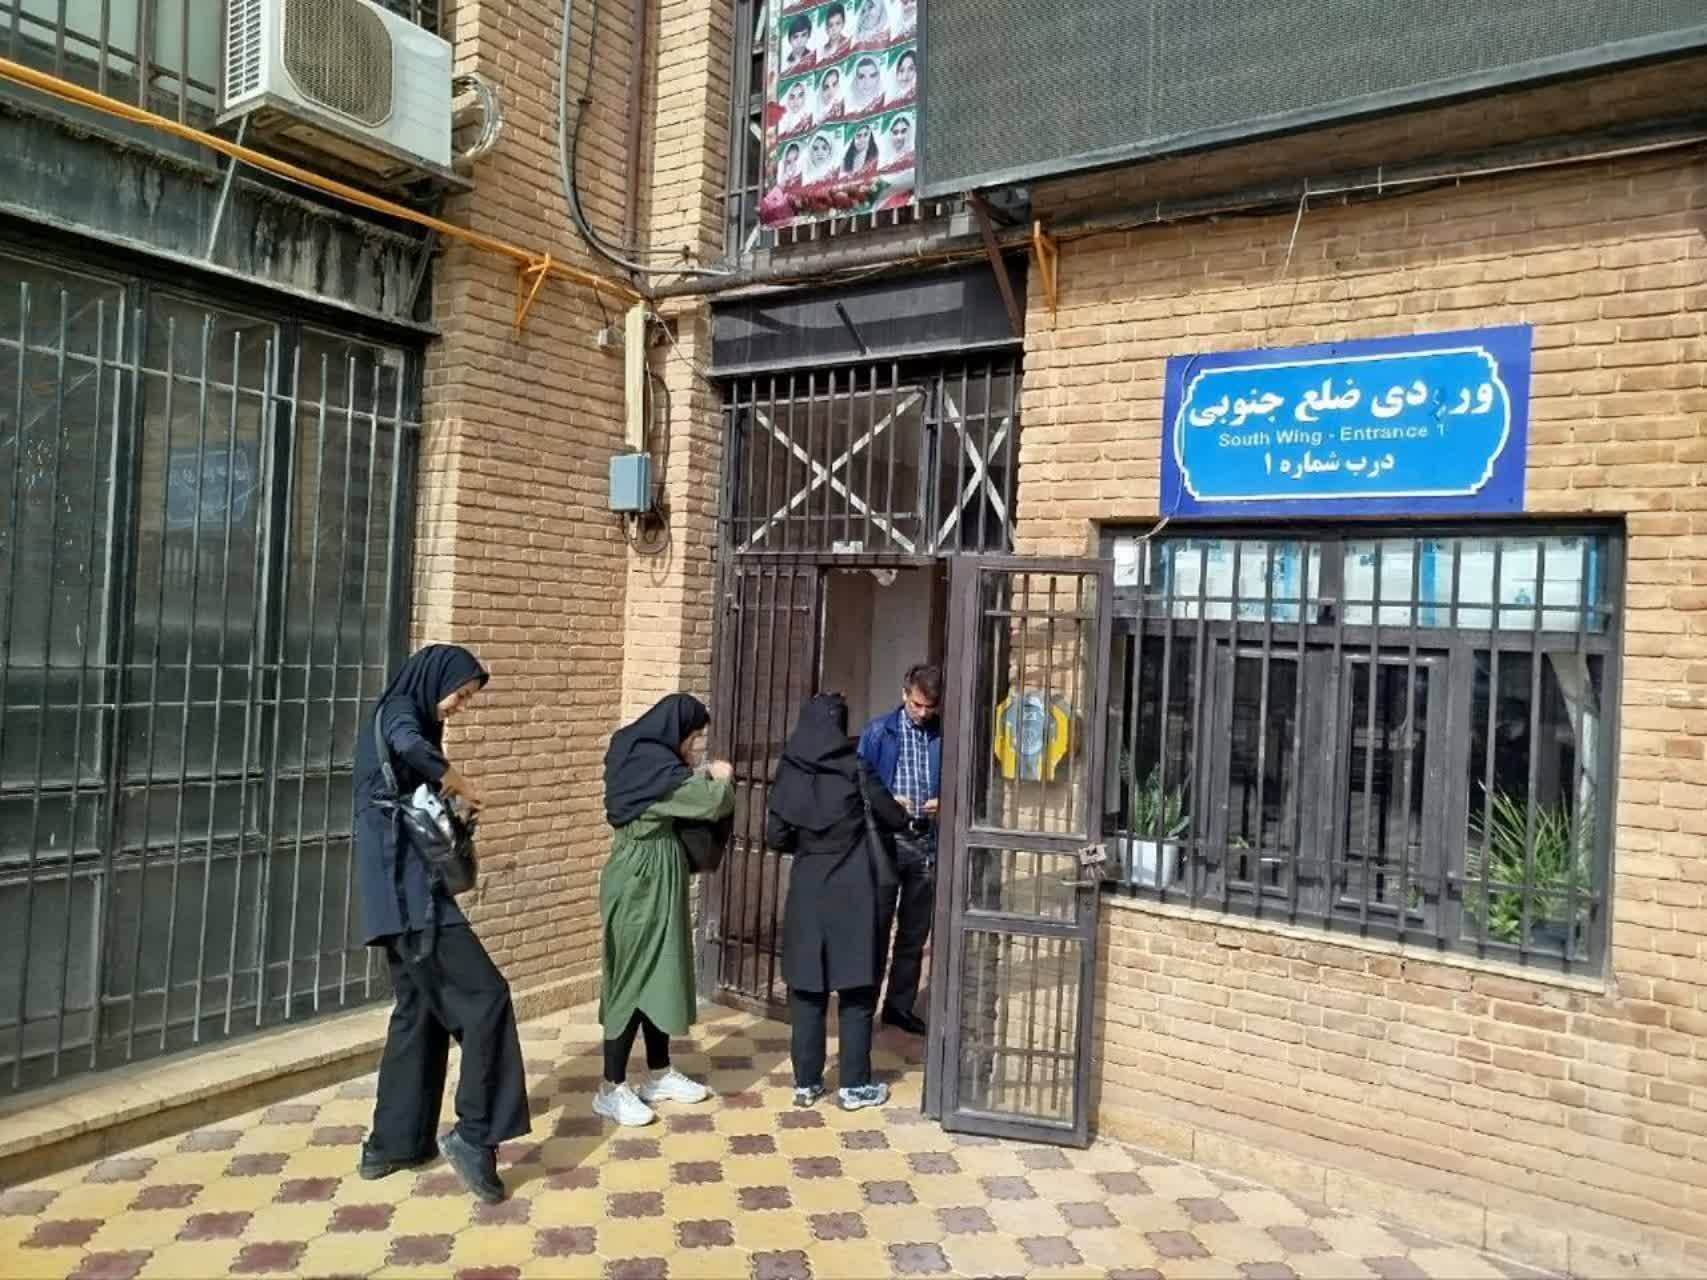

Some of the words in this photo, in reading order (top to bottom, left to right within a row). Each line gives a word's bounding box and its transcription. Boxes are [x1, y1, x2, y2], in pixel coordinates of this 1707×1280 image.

[1189, 388, 1285, 427] جنوبی
[1294, 377, 1361, 422] ضلع
[1370, 379, 1493, 418] وردی
[1218, 431, 1270, 448] South
[1276, 428, 1322, 446] Wing
[1340, 424, 1428, 442] Entrance
[1279, 449, 1341, 480] شماره
[1345, 453, 1395, 479] درب
